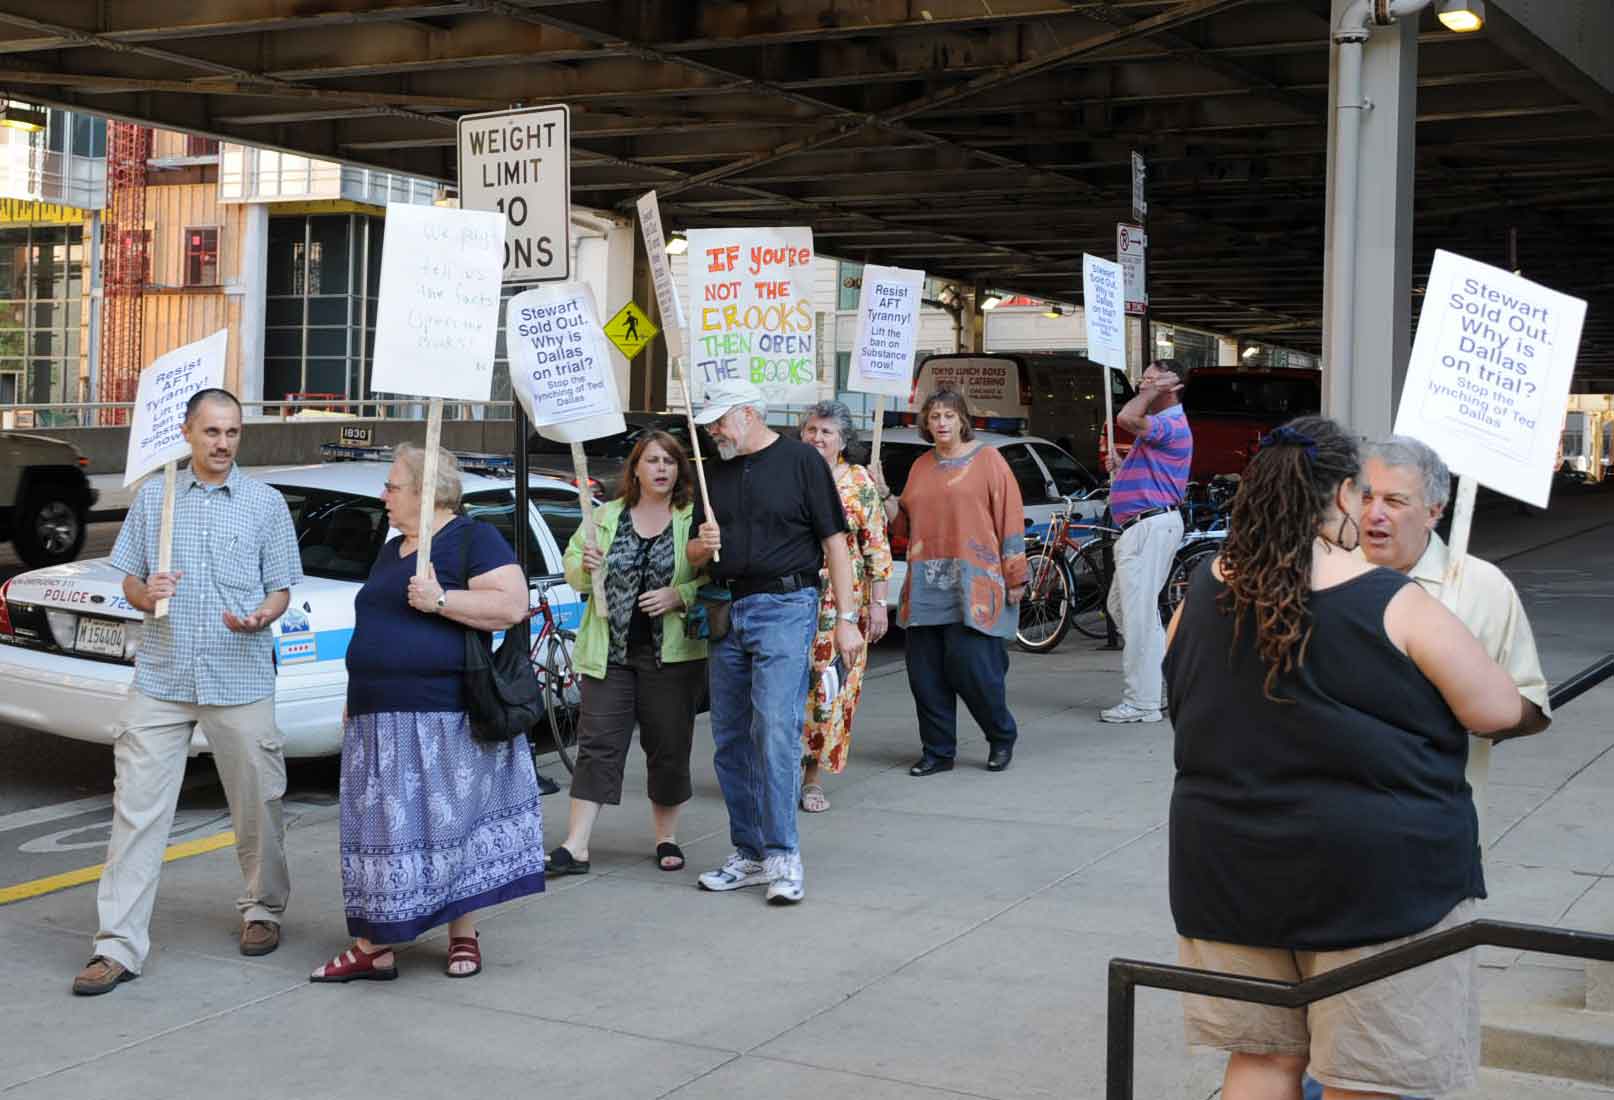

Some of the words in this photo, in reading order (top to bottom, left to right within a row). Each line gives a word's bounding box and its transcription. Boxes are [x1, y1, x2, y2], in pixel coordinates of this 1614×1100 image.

[469, 122, 556, 156] WEIGHT
[482, 158, 542, 187] LIMIT
[496, 196, 527, 226] 10
[502, 235, 553, 271] NS
[706, 245, 741, 273] IF
[705, 281, 742, 301] NOT
[755, 281, 791, 299] THE
[875, 284, 908, 297] Resist
[1464, 278, 1548, 323] Stewart
[521, 299, 578, 321] Stewart
[879, 298, 902, 309] AFT
[519, 320, 552, 337] Sold
[556, 314, 588, 330] Out.
[702, 300, 813, 333] CROOKS
[868, 309, 911, 325] Tyranny!
[1449, 293, 1501, 324] Sold
[1508, 315, 1553, 346] Out.
[531, 335, 564, 349] Why
[569, 330, 582, 343] is
[698, 332, 752, 356] THEN
[759, 334, 812, 354] OPEN
[870, 338, 886, 347] ban
[888, 341, 900, 349] on
[871, 327, 885, 336] Lift
[887, 329, 901, 338] the
[1461, 315, 1509, 348] Why
[1516, 338, 1535, 358] is
[537, 346, 584, 365] Dallas
[862, 347, 907, 360] Substance
[870, 360, 894, 369] now!
[1459, 336, 1528, 375] Dallas
[156, 358, 202, 384] Resist
[533, 368, 552, 381] on
[556, 357, 593, 376] trial?
[697, 358, 740, 383] THE
[751, 356, 814, 384] BOOKS
[956, 367, 980, 376] LUNCH
[1441, 354, 1471, 375] on
[1479, 363, 1537, 398] trial?
[162, 371, 192, 392] AFT
[534, 387, 573, 403] lynching
[574, 384, 585, 393] of
[587, 381, 604, 390] Ted
[547, 378, 569, 389] Stop
[570, 375, 586, 384] the
[1457, 376, 1489, 397] Stop
[1492, 391, 1514, 406] the
[145, 376, 208, 411] Tyranny!
[556, 395, 584, 407] Dallas
[1428, 379, 1490, 411] lynching
[1493, 402, 1508, 416] of
[1513, 410, 1536, 430] Ted
[153, 404, 173, 422] Lift
[176, 399, 189, 410] th
[1458, 403, 1501, 429] Dallas
[140, 422, 181, 448] Substa
[152, 415, 174, 432] ban
[344, 428, 366, 439] 1830
[43, 588, 89, 603] POLICE
